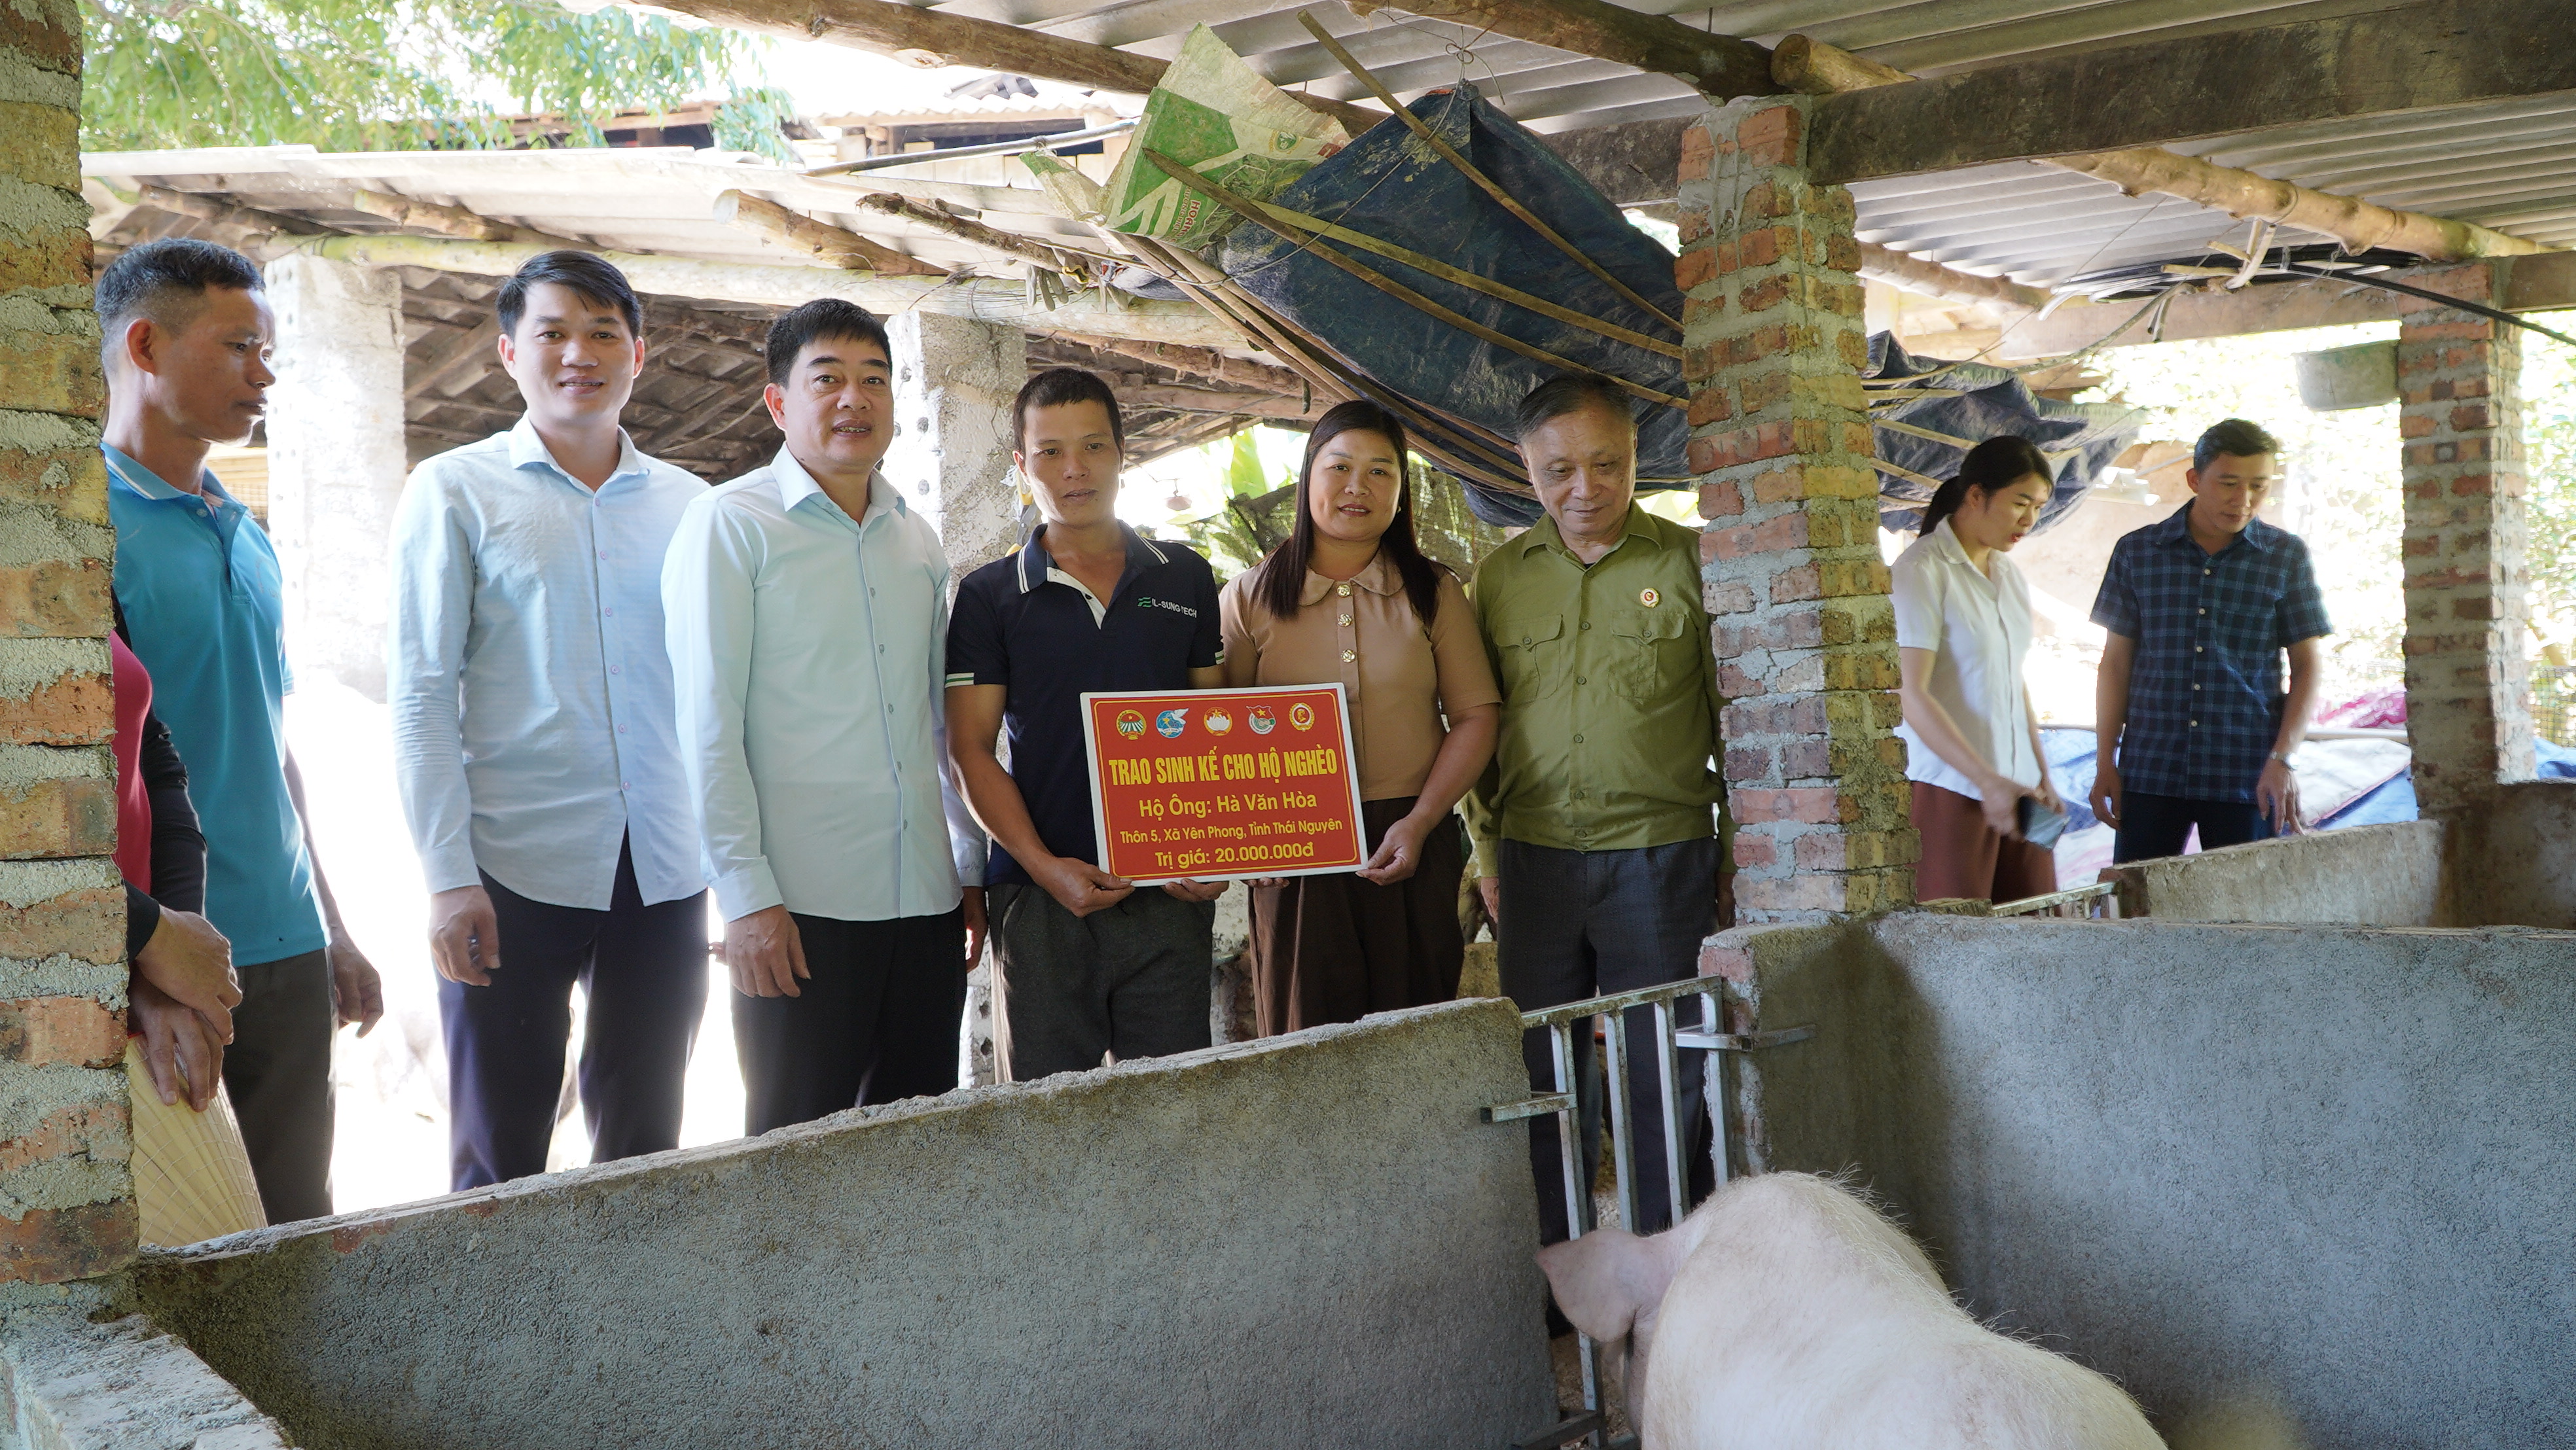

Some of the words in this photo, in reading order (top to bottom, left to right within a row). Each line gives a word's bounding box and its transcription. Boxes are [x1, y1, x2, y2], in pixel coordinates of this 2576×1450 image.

[1108, 758, 1152, 785] TRAO
[1155, 756, 1195, 784] SINH
[1197, 745, 1221, 781] KẾ
[1223, 753, 1255, 780] CHO
[1258, 747, 1281, 783] HỘ
[1283, 743, 1337, 777] NGHÈO
[1139, 798, 1165, 821] Hộ
[1169, 793, 1211, 818] Ông:
[1217, 794, 1241, 813] Hà
[1243, 793, 1278, 811] Văn
[1282, 790, 1317, 809] Hòa
[1120, 830, 1149, 844] Thôn
[1151, 829, 1162, 843] 5,
[1164, 828, 1181, 841] Xã
[1182, 827, 1206, 840] Yên
[1208, 826, 1247, 840] Phong,
[1248, 821, 1272, 836] Tỉnh
[1272, 820, 1296, 834] Thái
[1298, 818, 1343, 835] Nguyên
[1154, 851, 1173, 870] Trị
[1177, 848, 1211, 869] giá:
[1215, 841, 1314, 863] 20.000.000đ
